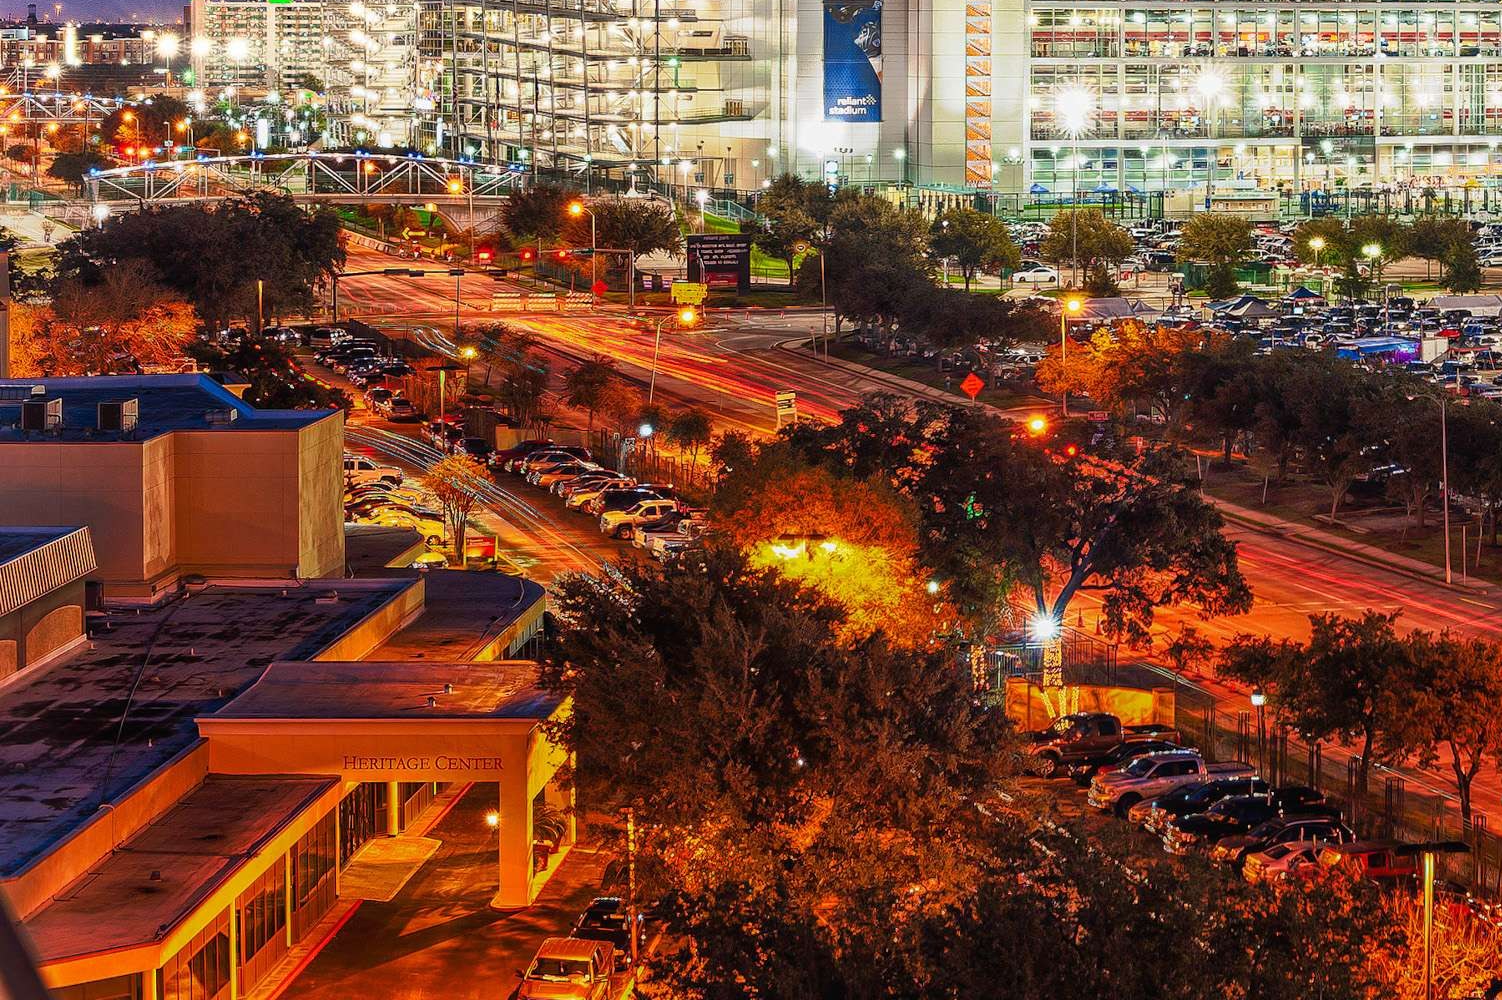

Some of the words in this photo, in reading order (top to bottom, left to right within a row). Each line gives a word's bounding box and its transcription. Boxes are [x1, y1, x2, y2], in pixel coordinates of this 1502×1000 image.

[837, 96, 867, 106] reliant
[829, 105, 866, 115] stadium
[343, 755, 430, 770] HERITAGE
[435, 755, 504, 770] CENTER
